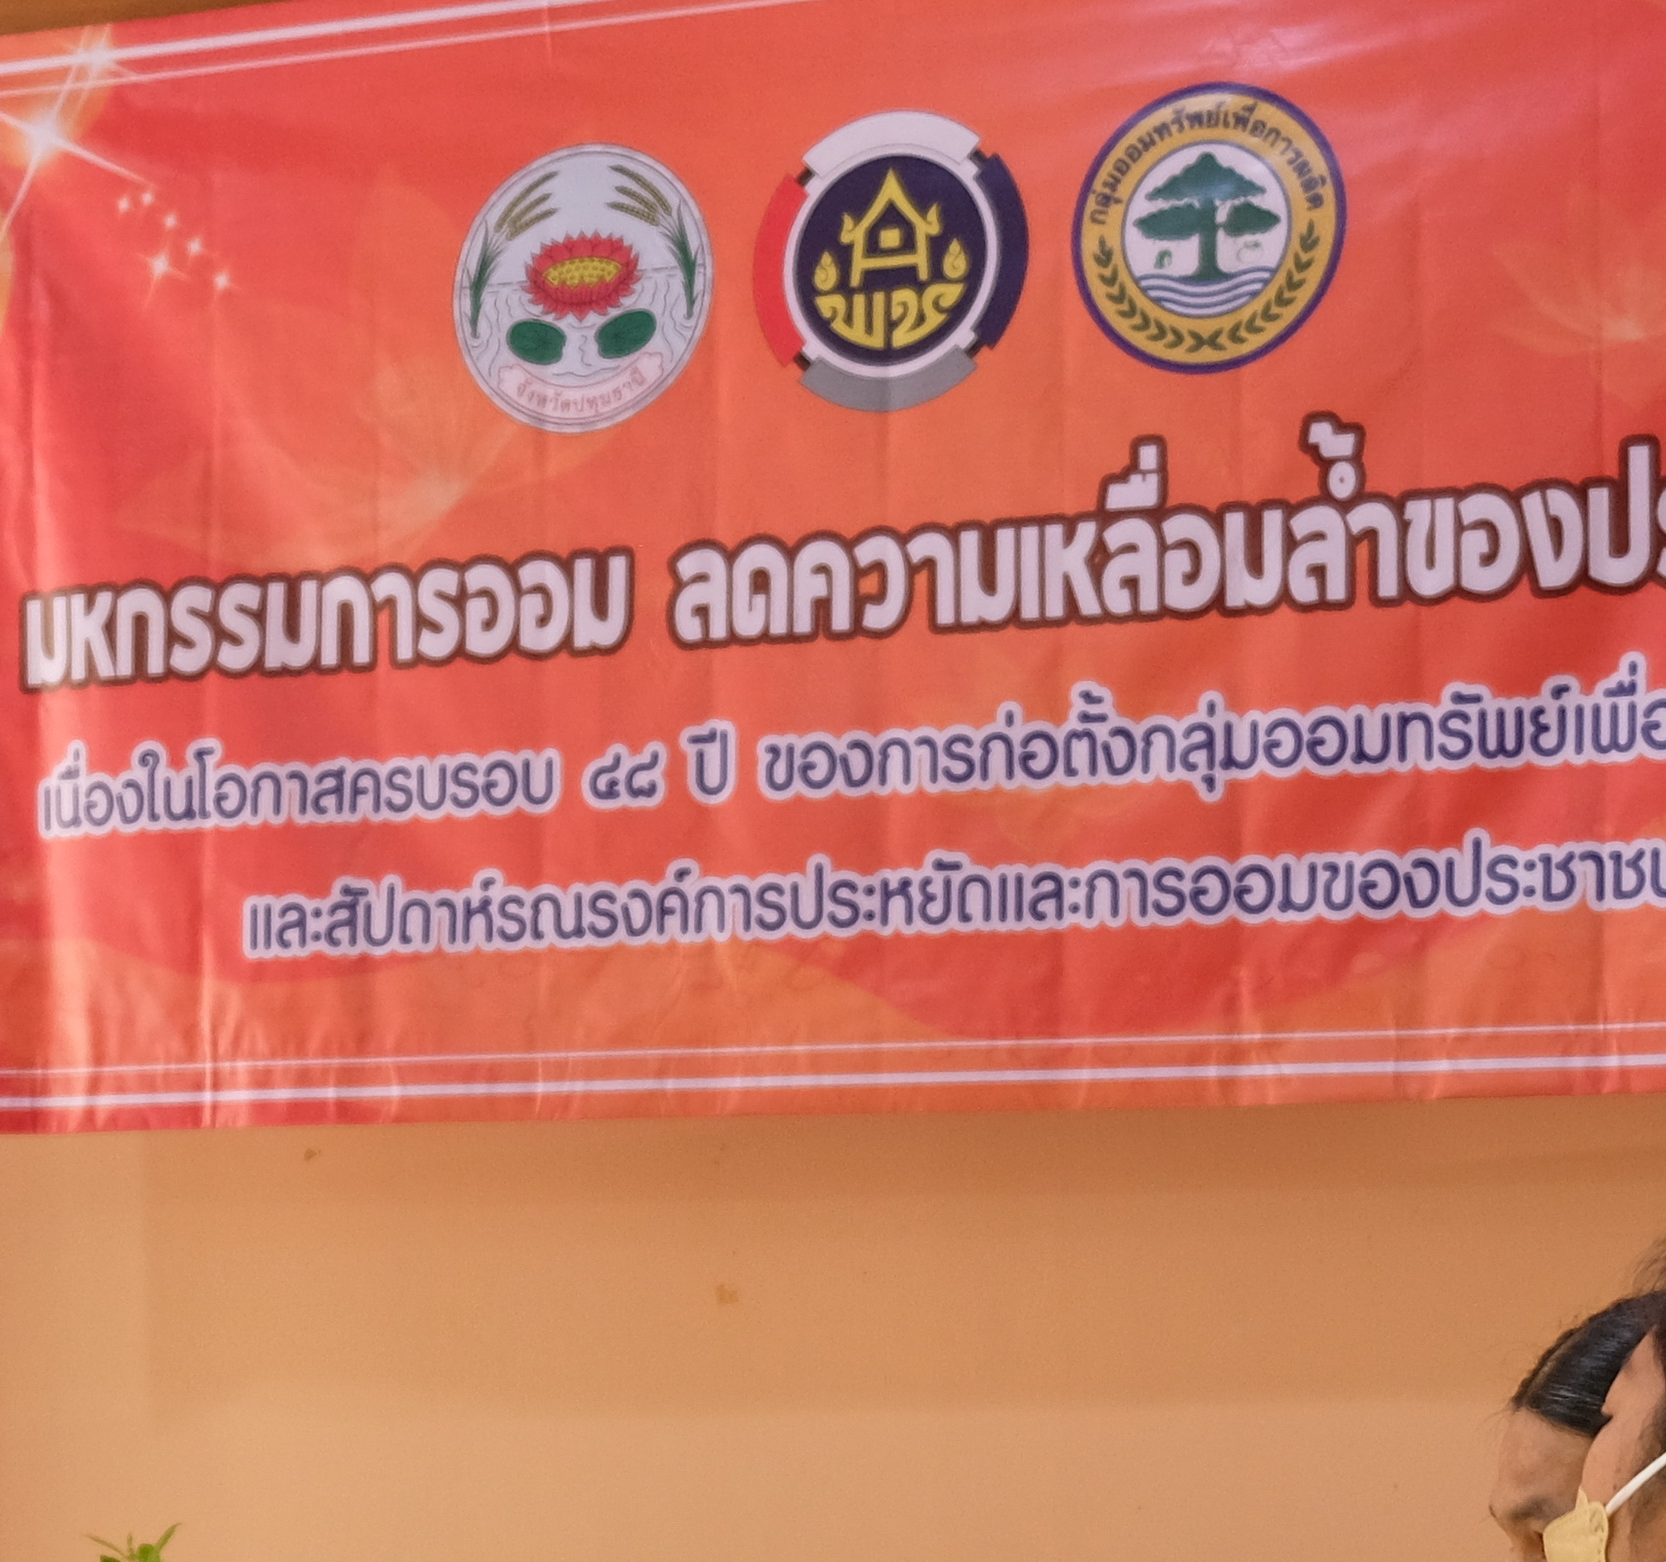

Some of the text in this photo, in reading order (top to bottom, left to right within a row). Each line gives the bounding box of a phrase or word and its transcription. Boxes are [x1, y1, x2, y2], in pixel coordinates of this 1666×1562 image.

[22, 548, 633, 692] มหกรรมการออม
[40, 739, 556, 836] เนื่องในโอกาสครบรอบ
[584, 746, 665, 808] ๔๘
[686, 724, 733, 802] ปี
